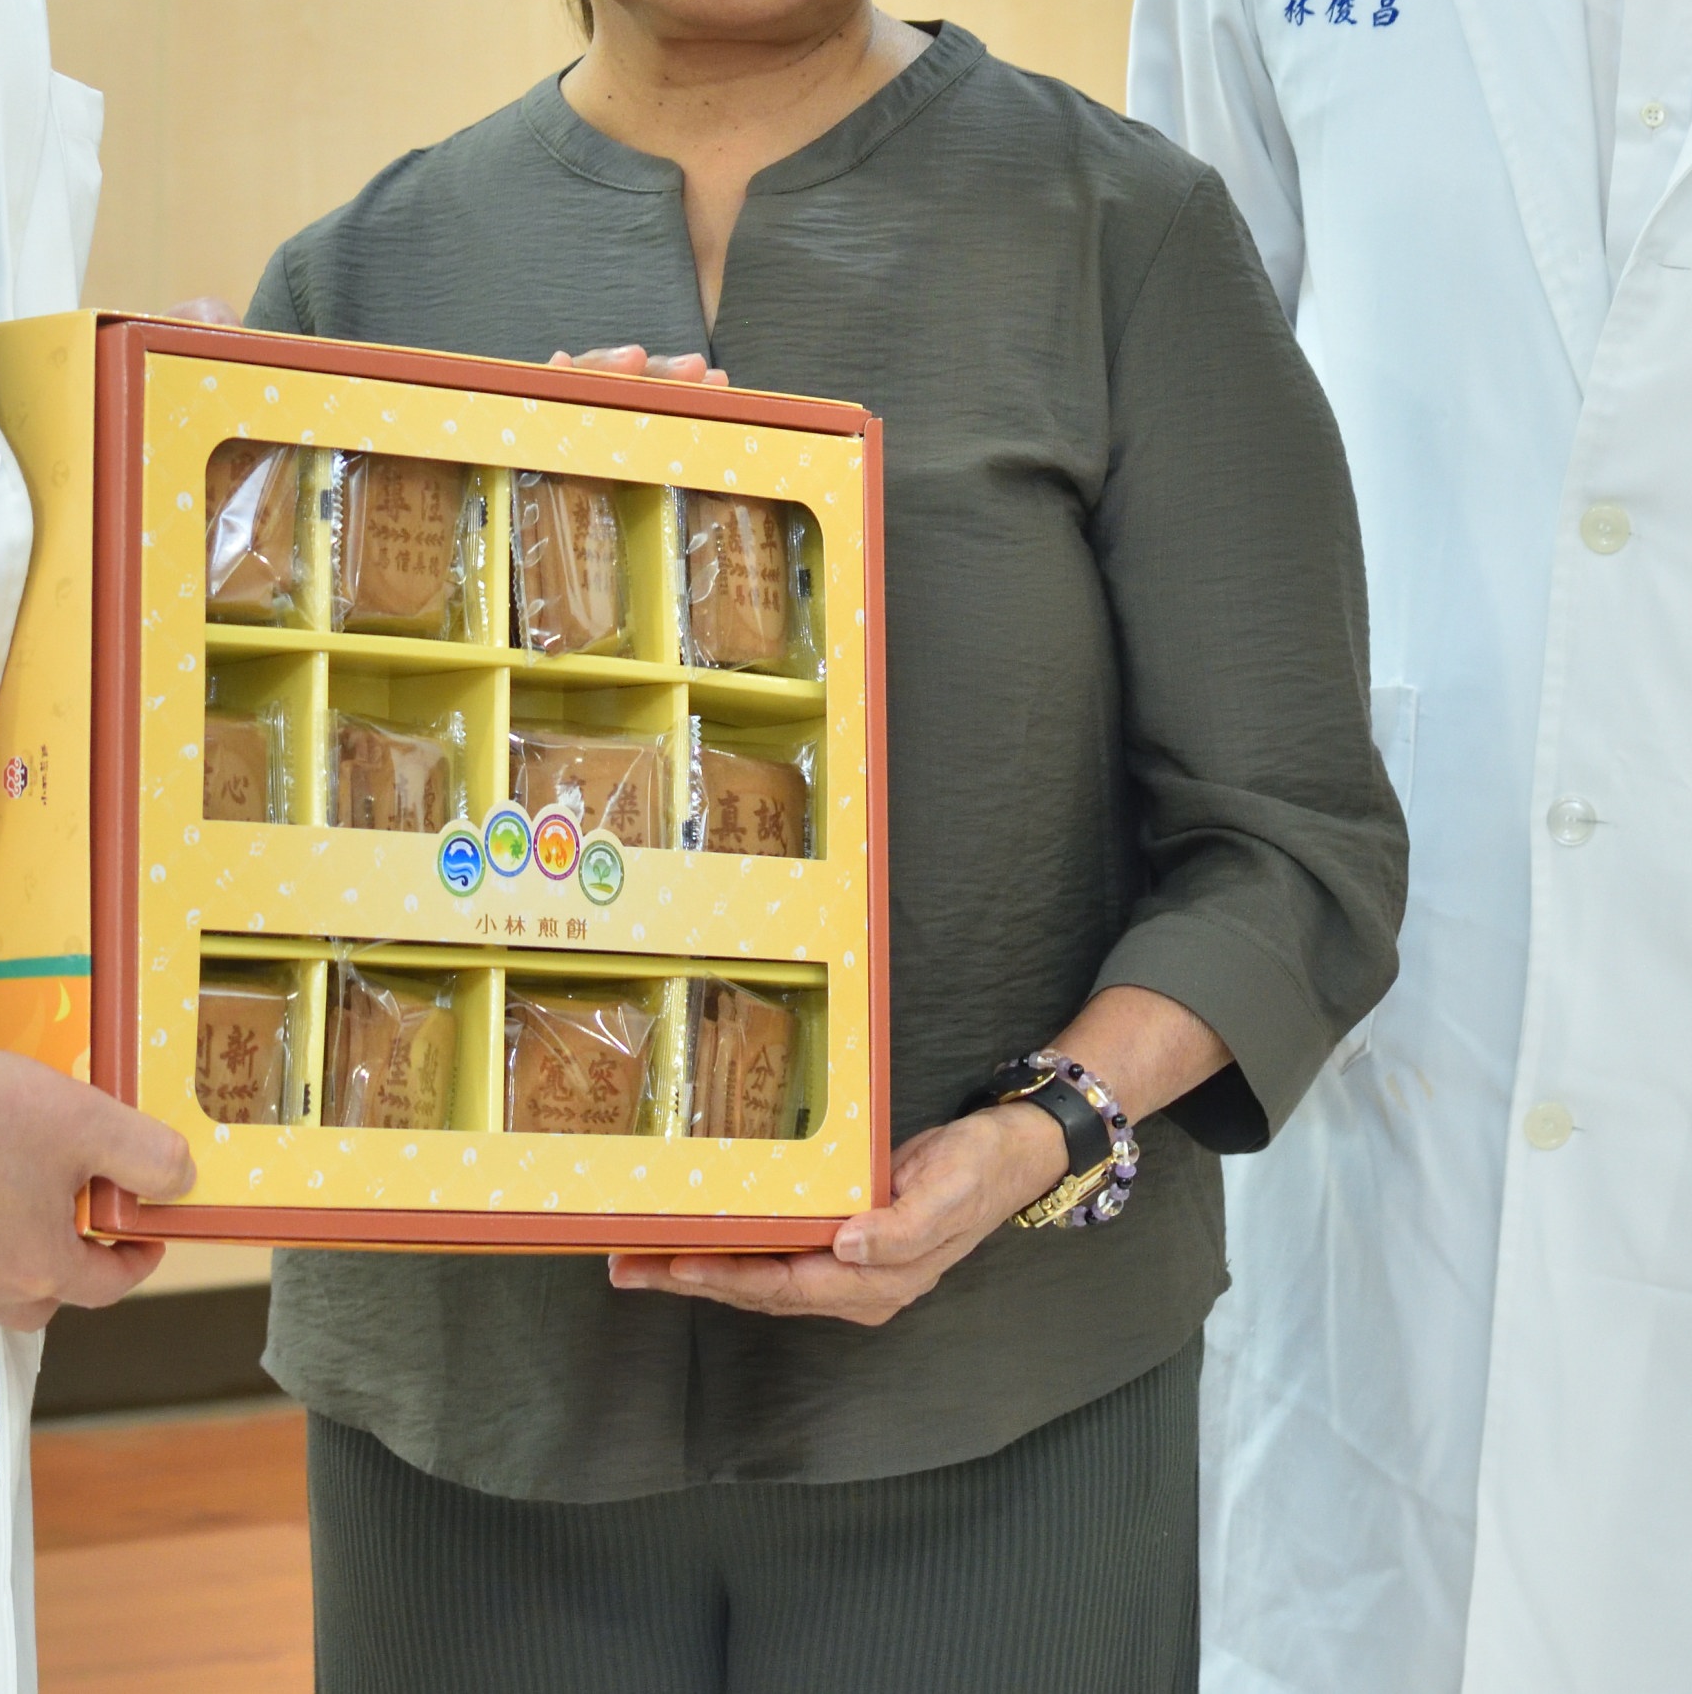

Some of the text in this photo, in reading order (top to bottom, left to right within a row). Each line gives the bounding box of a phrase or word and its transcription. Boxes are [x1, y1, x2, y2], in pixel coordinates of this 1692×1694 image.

[710, 790, 788, 856] 真誠
[475, 913, 588, 941] 小林煎餅
[539, 1048, 620, 1103] 寬容
